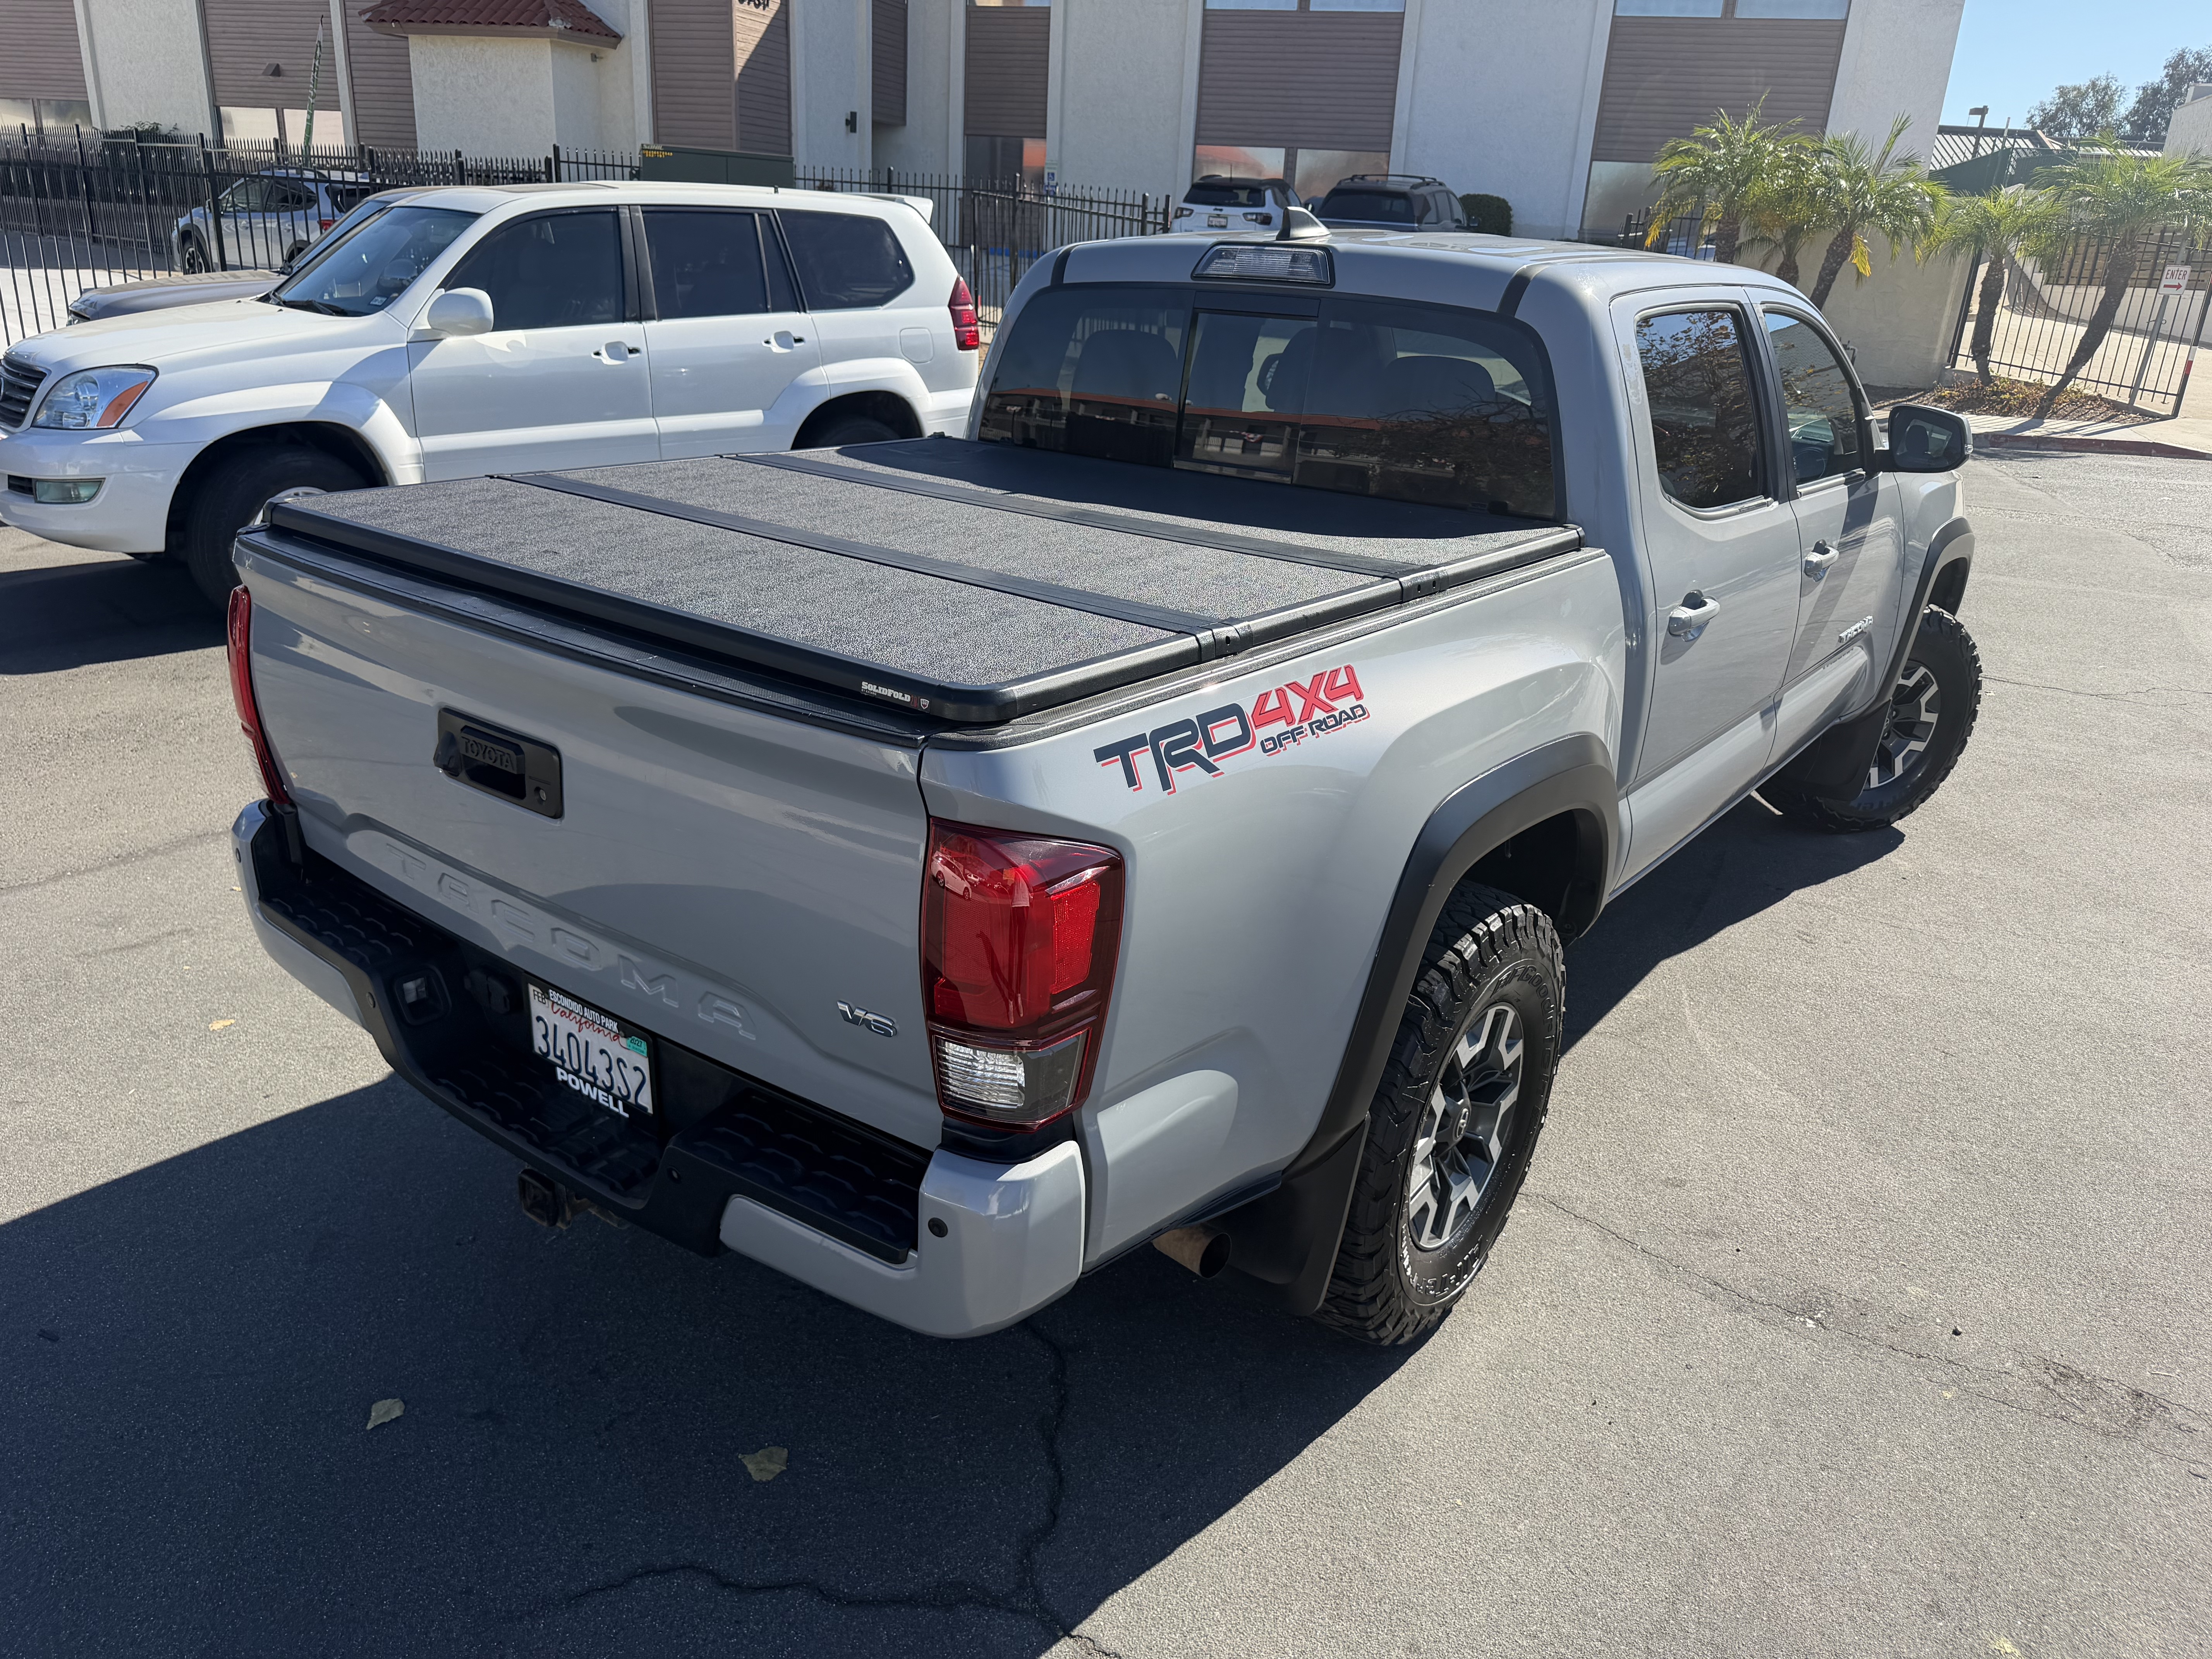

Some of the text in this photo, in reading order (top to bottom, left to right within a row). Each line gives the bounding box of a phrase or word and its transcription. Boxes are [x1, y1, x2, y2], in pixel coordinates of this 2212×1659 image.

[2165, 270, 2187, 280] ENTER
[862, 682, 910, 702] SOLIDFOLD
[1093, 664, 1364, 795] TRD 4X4
[1260, 704, 1370, 756] OFF ROAD
[461, 736, 514, 771] TOYOTA
[386, 843, 757, 1040] TACOMA
[533, 989, 546, 1005] FEB
[549, 989, 619, 1033] ESCONDIDO AUTO PARK
[837, 1000, 897, 1037] V6
[551, 1001, 623, 1044] California
[630, 1038, 642, 1048] 2027
[536, 1015, 648, 1113] 34043S2
[556, 1066, 629, 1118] POWELL
